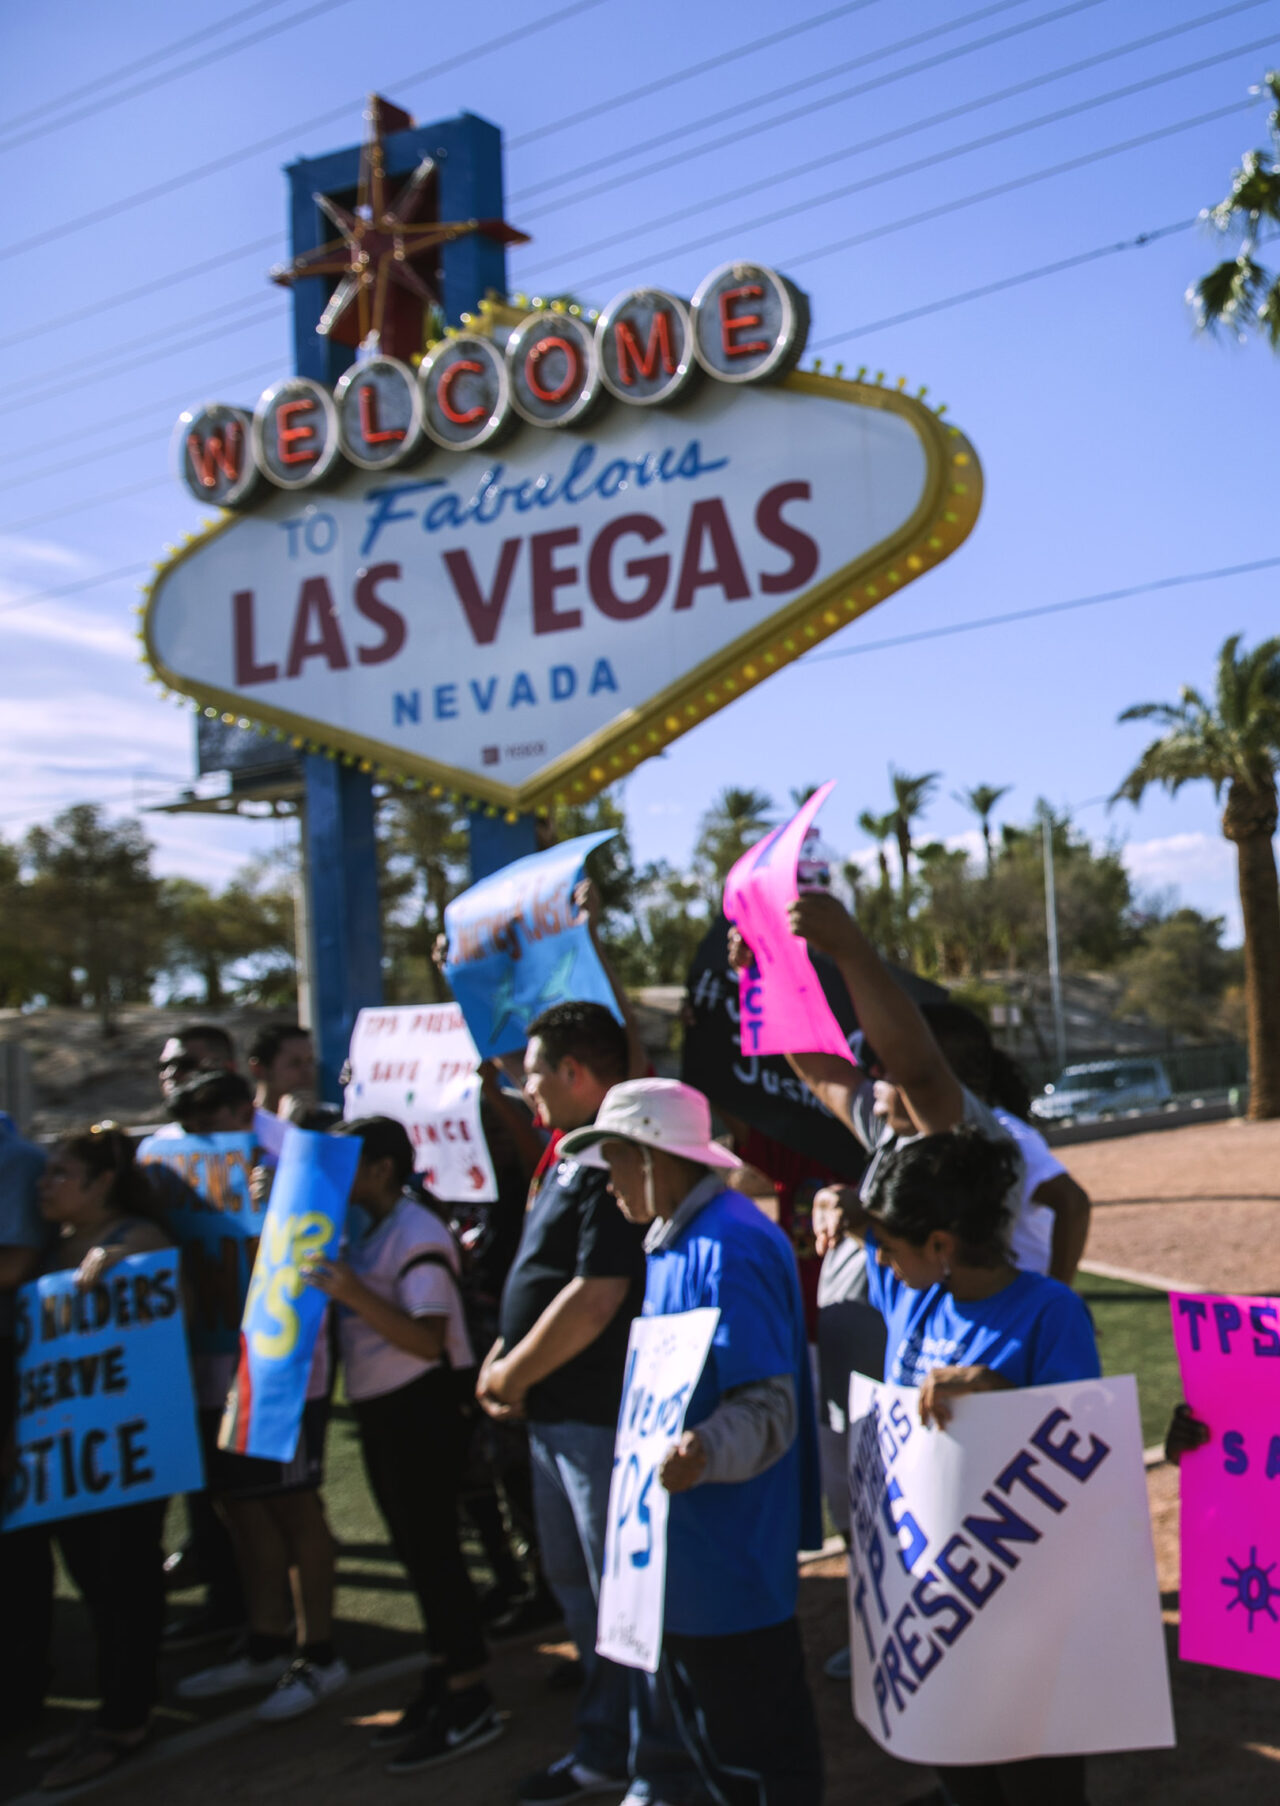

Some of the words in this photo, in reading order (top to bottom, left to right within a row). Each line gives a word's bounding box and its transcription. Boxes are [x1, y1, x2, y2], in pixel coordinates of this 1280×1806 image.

[188, 283, 768, 489] WELCOME
[281, 511, 338, 560] TO
[361, 438, 729, 557] Fabulous
[232, 561, 408, 688] LAS
[443, 479, 820, 647] VEGAS
[393, 656, 619, 727] NEVADA
[18, 1345, 127, 1415] SERVE
[872, 1407, 1111, 1739] PRESENTE
